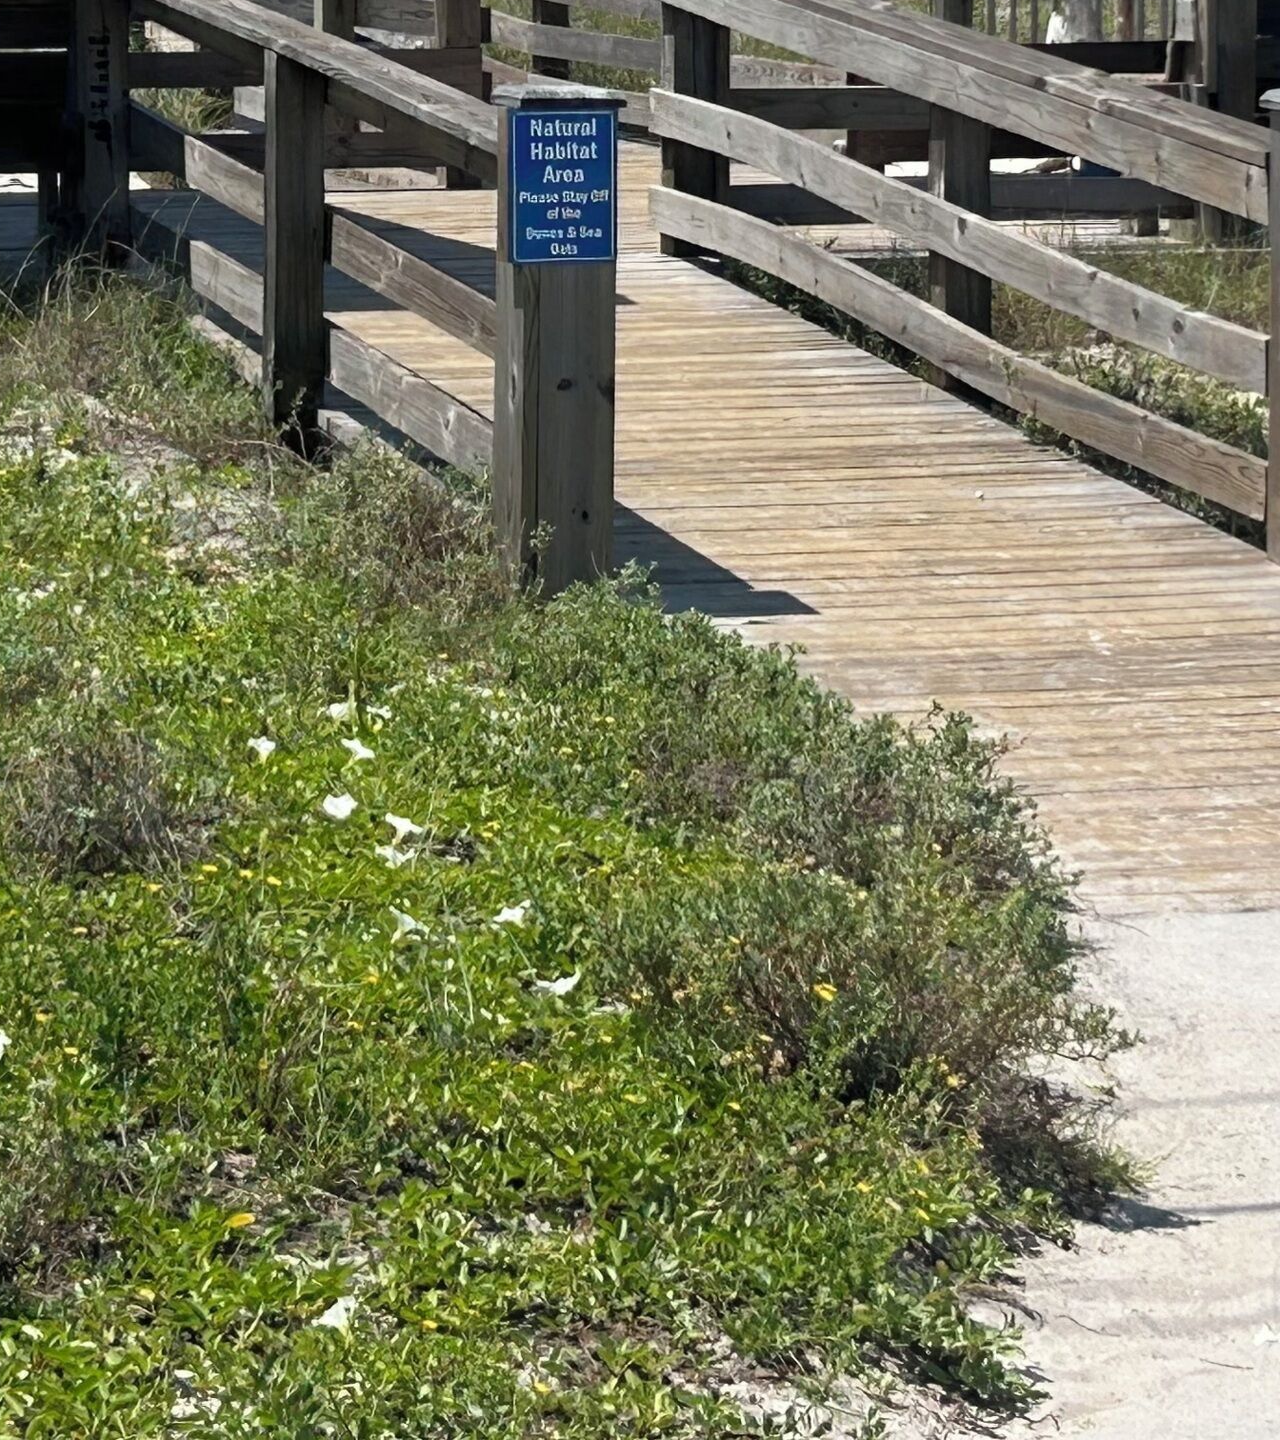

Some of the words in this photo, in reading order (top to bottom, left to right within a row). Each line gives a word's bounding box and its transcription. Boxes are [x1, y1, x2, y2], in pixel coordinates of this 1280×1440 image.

[530, 118, 597, 137] Natural
[530, 142, 598, 160] Habitat
[543, 165, 585, 184] Area
[519, 191, 559, 204] Please
[562, 190, 588, 205] Stay
[566, 225, 577, 239] &
